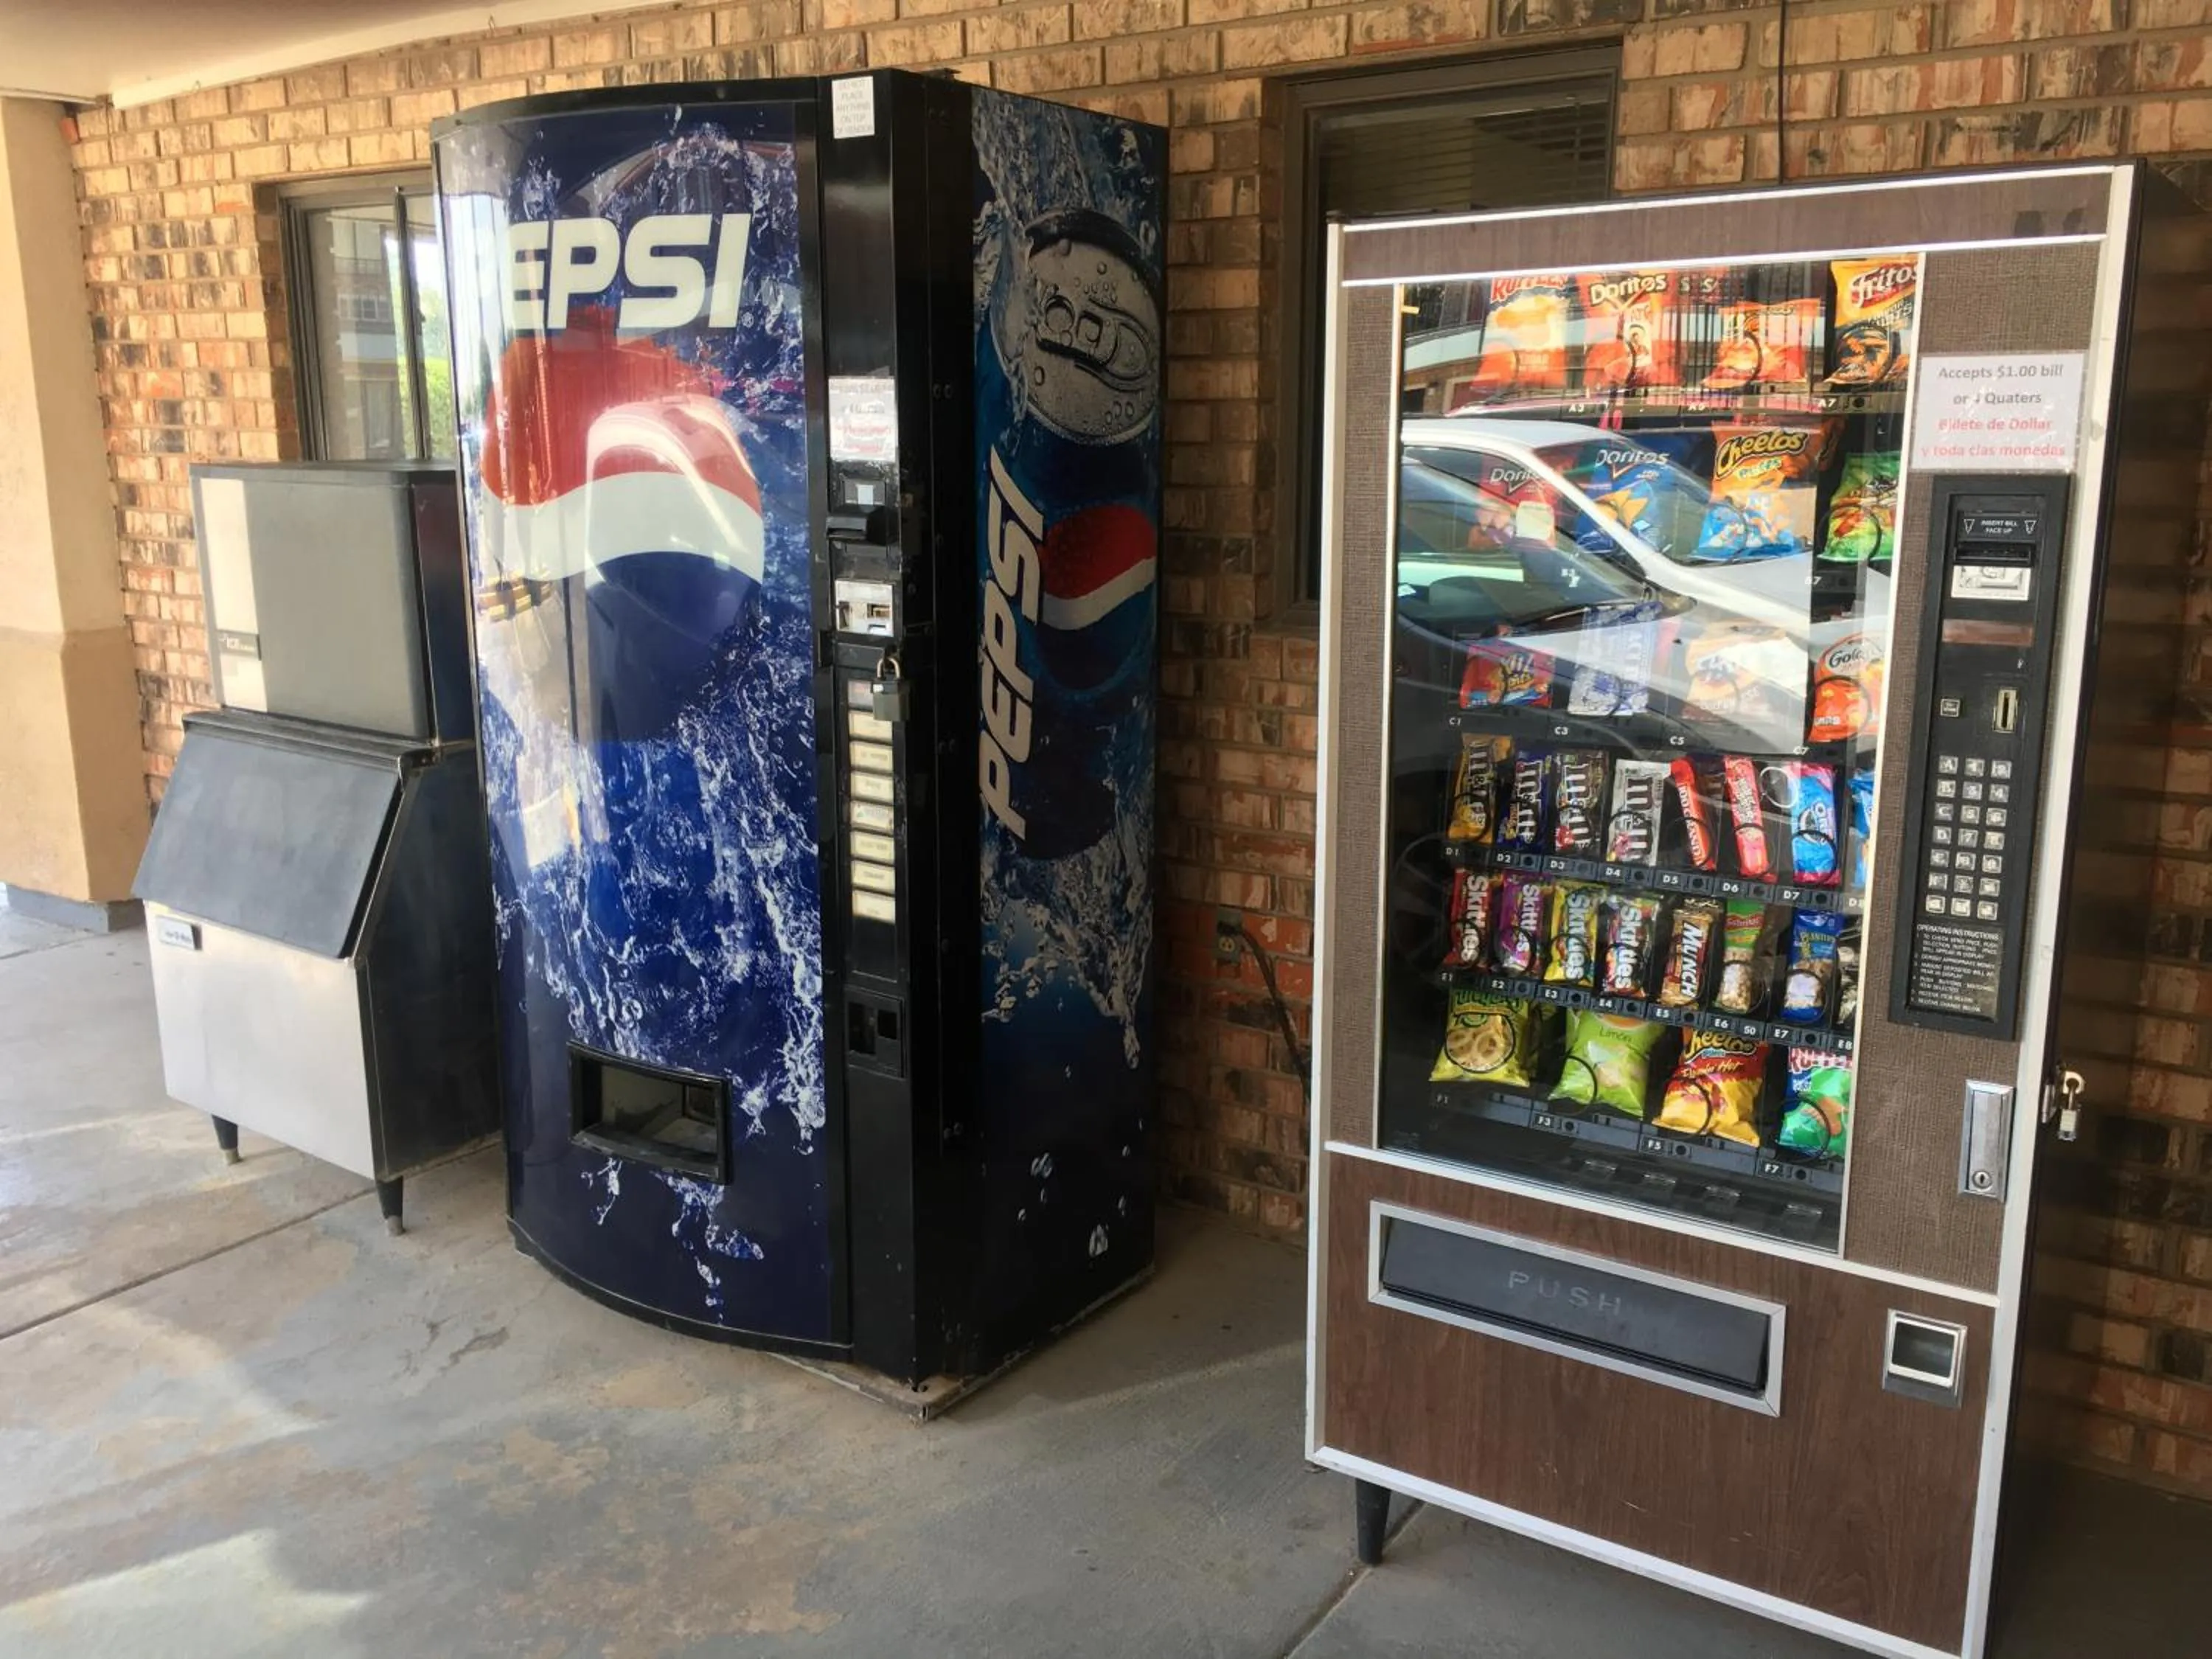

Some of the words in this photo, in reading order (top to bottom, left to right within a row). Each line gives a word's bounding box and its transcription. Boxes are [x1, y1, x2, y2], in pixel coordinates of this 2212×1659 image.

[509, 213, 751, 329] EPSI
[1590, 274, 1667, 307] Doritos
[1938, 366, 1992, 382] Accepts
[1997, 364, 2037, 380] $1.00
[2041, 364, 2064, 378] bill
[1953, 394, 1969, 405] or
[1985, 392, 2042, 406] Quaters
[1987, 417, 2005, 431] de
[1717, 428, 1807, 475] Cheetos
[1999, 444, 2065, 456] monedas
[1595, 449, 1671, 467] Doritos
[1490, 467, 1538, 483] Dori
[979, 444, 1044, 841] PEPSI
[1554, 726, 1569, 736] C3
[1497, 854, 1511, 863] D2
[1551, 860, 1565, 870] D3
[1605, 867, 1621, 877] D4
[1663, 875, 1678, 884] D5
[1722, 883, 1739, 893] D6
[1784, 891, 1801, 900] D7
[1680, 922, 1703, 998] MUNCH
[1492, 980, 1505, 990] E2
[1545, 989, 1558, 999] E3
[1599, 998, 1613, 1008] E4
[1656, 1009, 1669, 1018] E5
[1714, 1019, 1728, 1029] E6
[1774, 1029, 1789, 1039] E7
[1838, 1040, 1853, 1051] E8
[1538, 1116, 1551, 1126] F3
[1764, 1164, 1779, 1174] F7
[1508, 1270, 1621, 1316] PUSH
